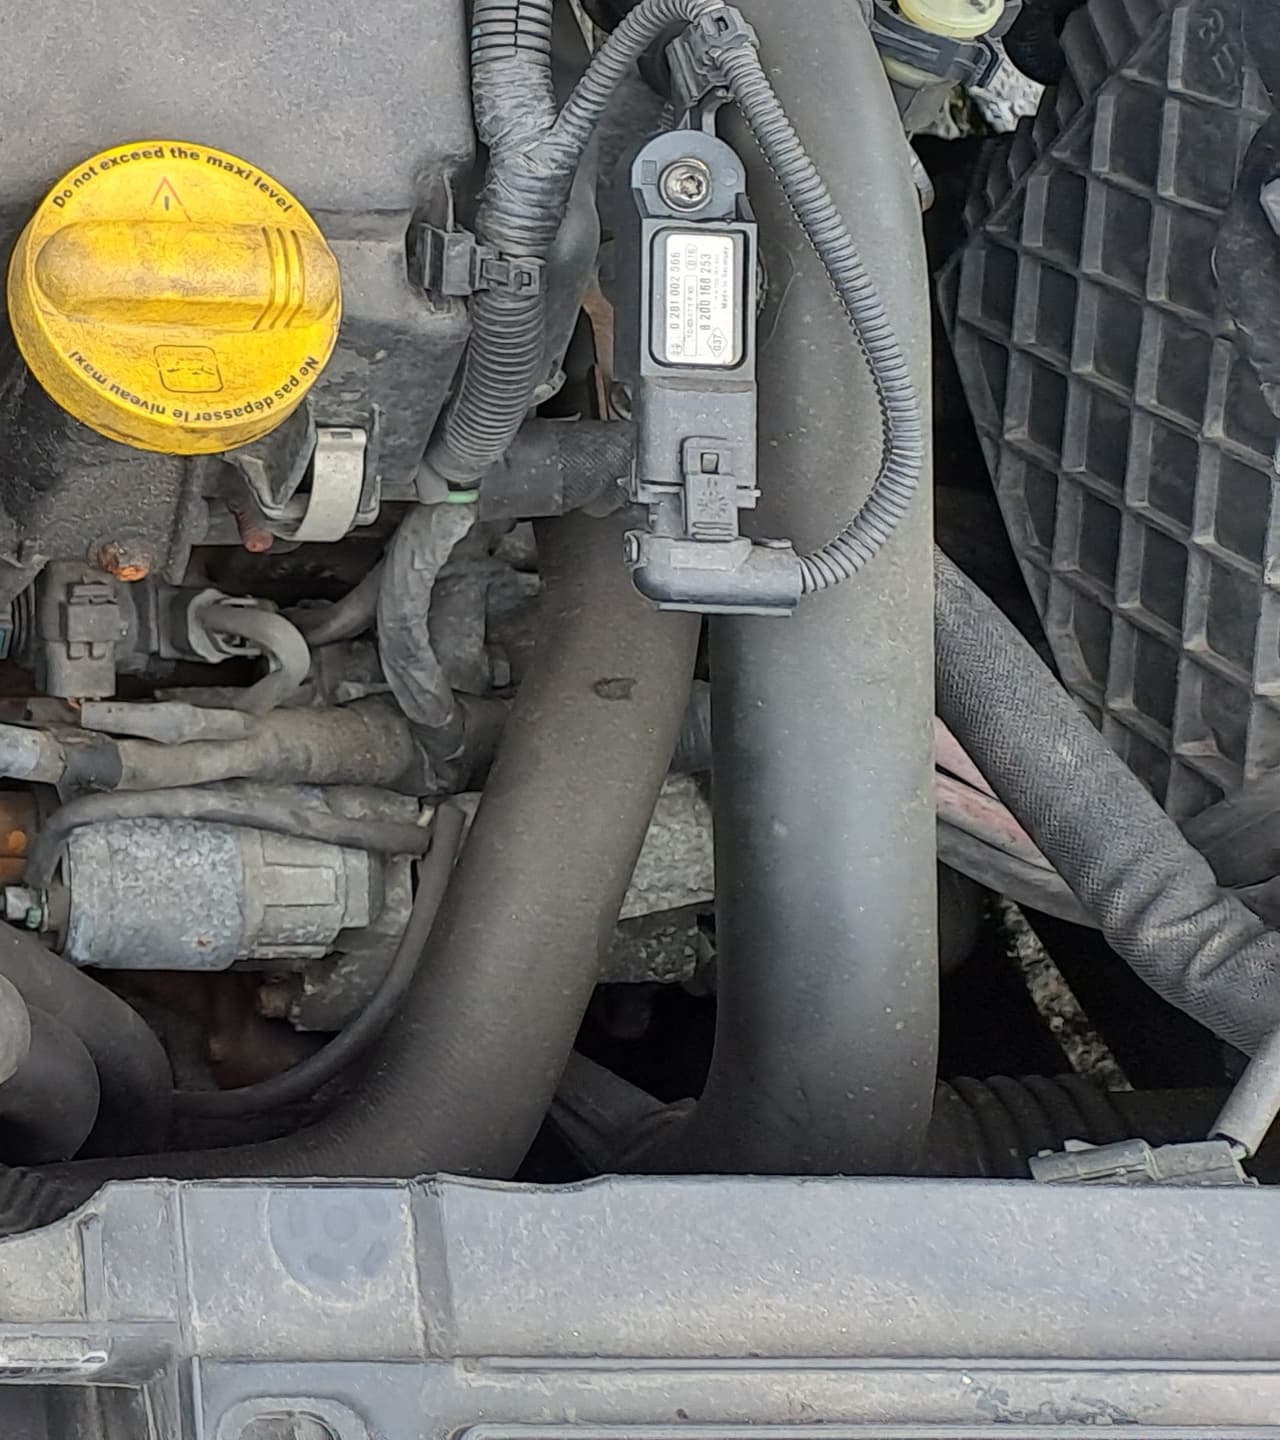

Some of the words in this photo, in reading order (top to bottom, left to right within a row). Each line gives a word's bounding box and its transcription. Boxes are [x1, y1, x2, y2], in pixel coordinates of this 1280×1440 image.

[52, 188, 74, 210] Do
[73, 166, 98, 190] not
[99, 145, 166, 171] exceed
[169, 146, 201, 162] the
[205, 153, 253, 181] maxi
[252, 175, 295, 214] level
[700, 253, 711, 274] 253
[700, 277, 711, 296] 168
[700, 300, 711, 321] 200
[67, 349, 108, 387] maxi
[297, 354, 320, 377] Ne
[107, 382, 167, 417] niveau
[273, 374, 299, 404] pas
[172, 407, 190, 422] le
